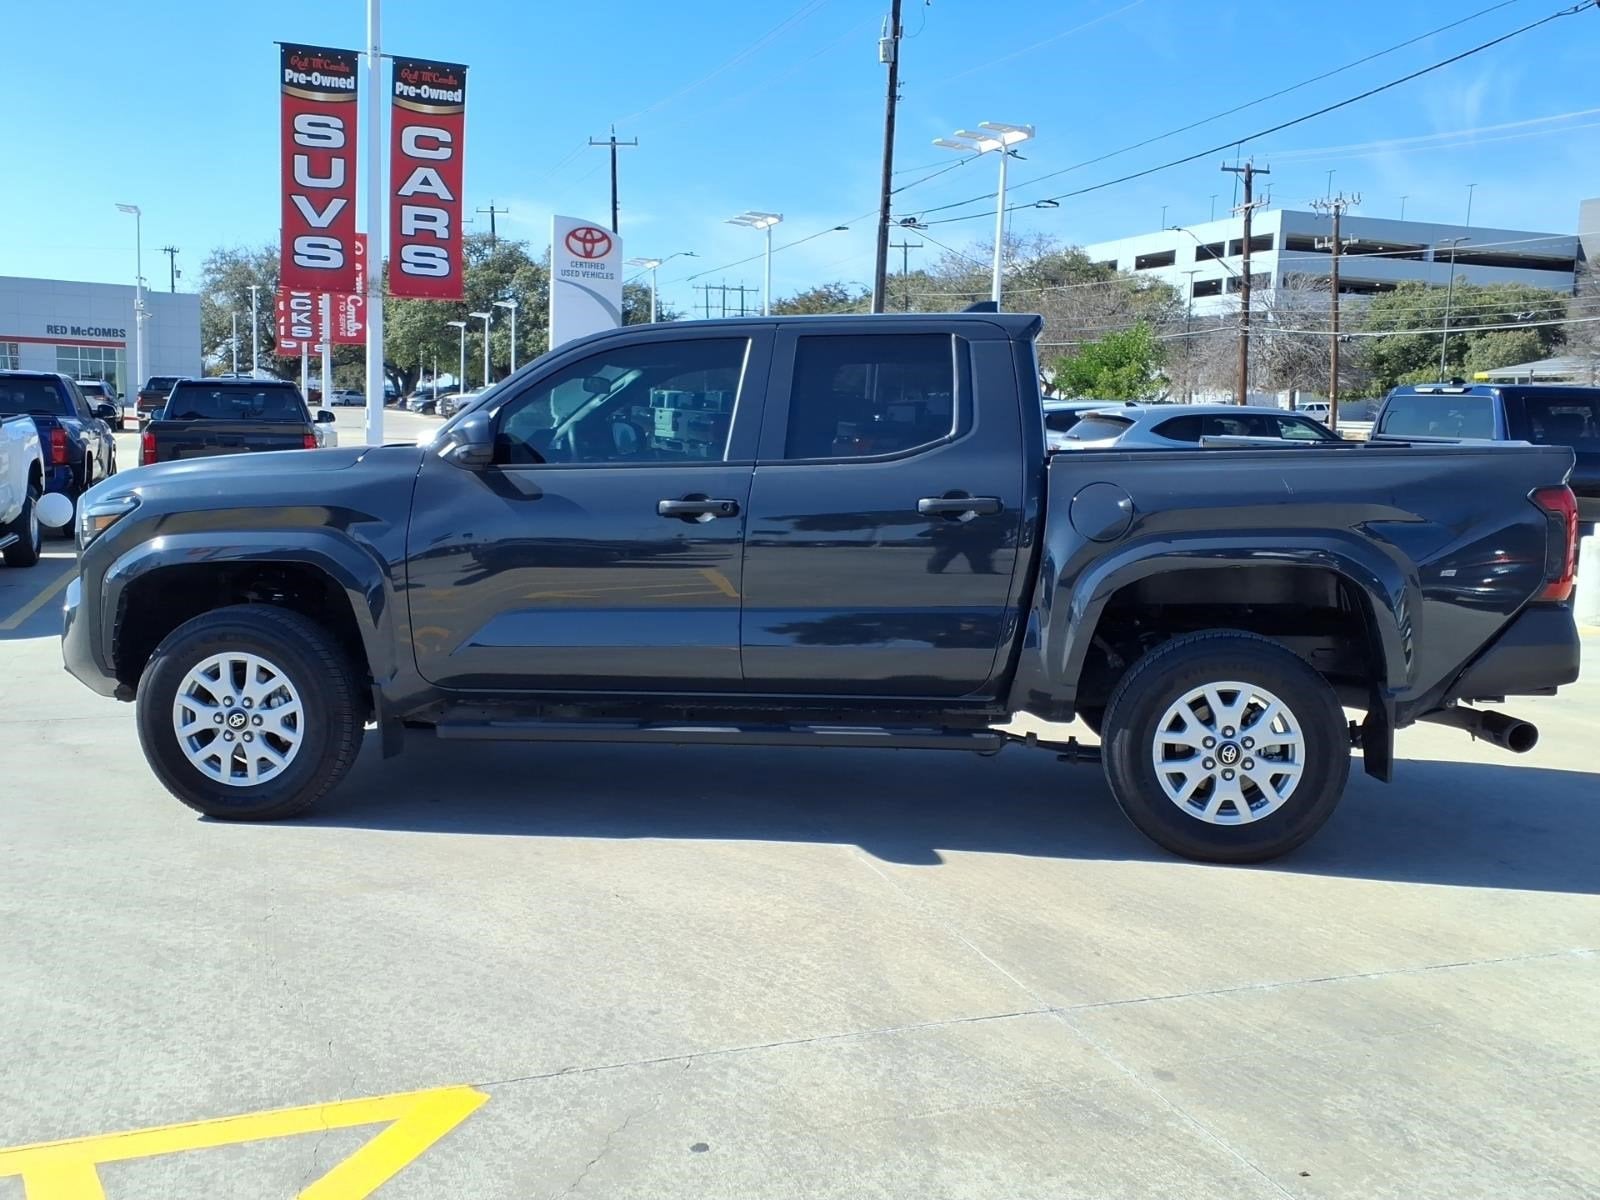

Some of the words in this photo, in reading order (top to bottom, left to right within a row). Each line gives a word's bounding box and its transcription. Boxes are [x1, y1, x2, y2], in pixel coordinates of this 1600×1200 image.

[284, 69, 355, 89] Pre-Owned
[395, 82, 462, 102] Pre-Owned
[290, 114, 348, 269] SUVS
[397, 125, 454, 277] CARS
[560, 269, 580, 278] USED
[581, 270, 615, 280] VEHICLES
[570, 261, 605, 270] CERTIFIED
[46, 324, 68, 336] RED
[70, 326, 126, 338] McCOMBS
